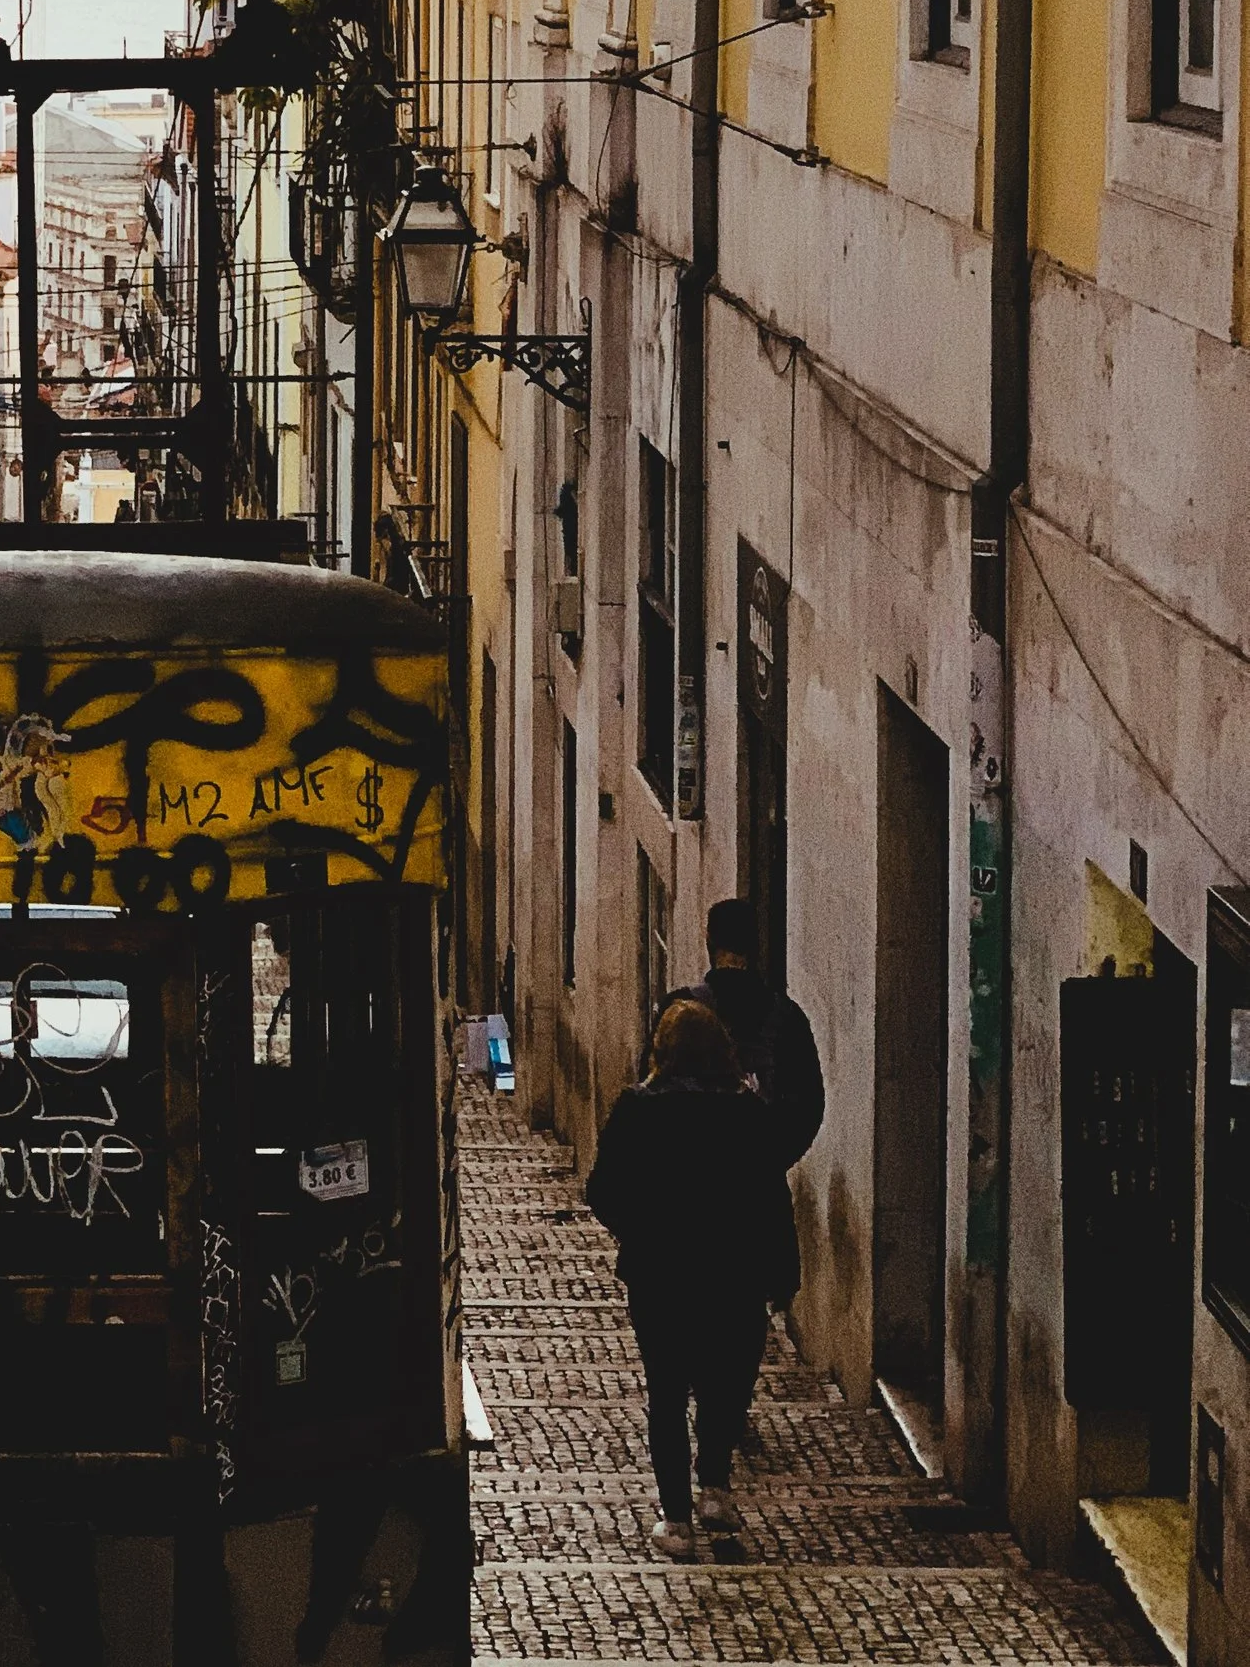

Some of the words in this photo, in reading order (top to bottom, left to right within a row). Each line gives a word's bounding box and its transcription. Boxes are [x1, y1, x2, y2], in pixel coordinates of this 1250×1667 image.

[159, 781, 229, 827] M2
[308, 1167, 342, 1189] 3.80
[345, 1163, 357, 1181] €
